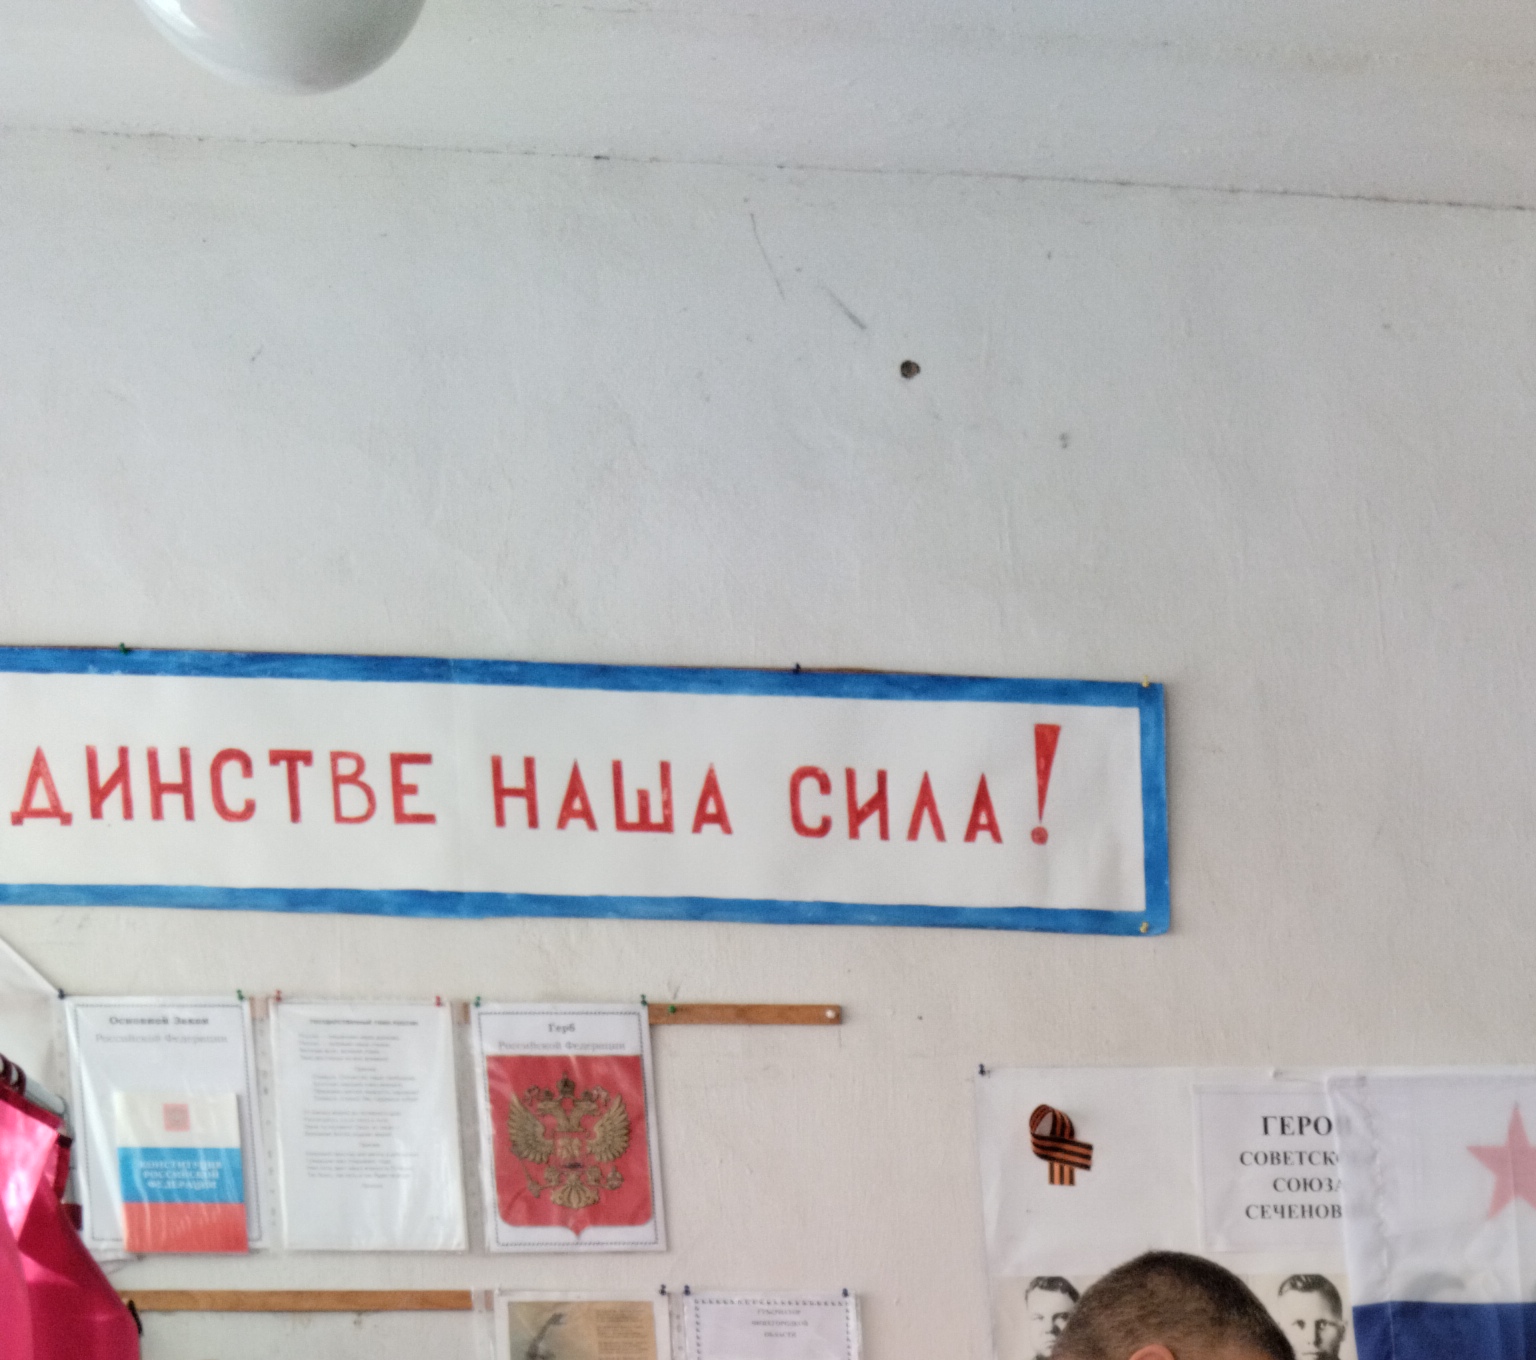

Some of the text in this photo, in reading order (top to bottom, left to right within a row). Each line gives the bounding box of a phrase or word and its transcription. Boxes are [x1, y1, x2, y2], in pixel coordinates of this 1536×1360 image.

[10, 723, 1062, 846] ДИНСТВЕ НАША СИЛА!
[548, 1023, 576, 1035] Герб
[1261, 1115, 1334, 1137] ГЕРО
[1239, 1150, 1339, 1167] СОВЕТСК
